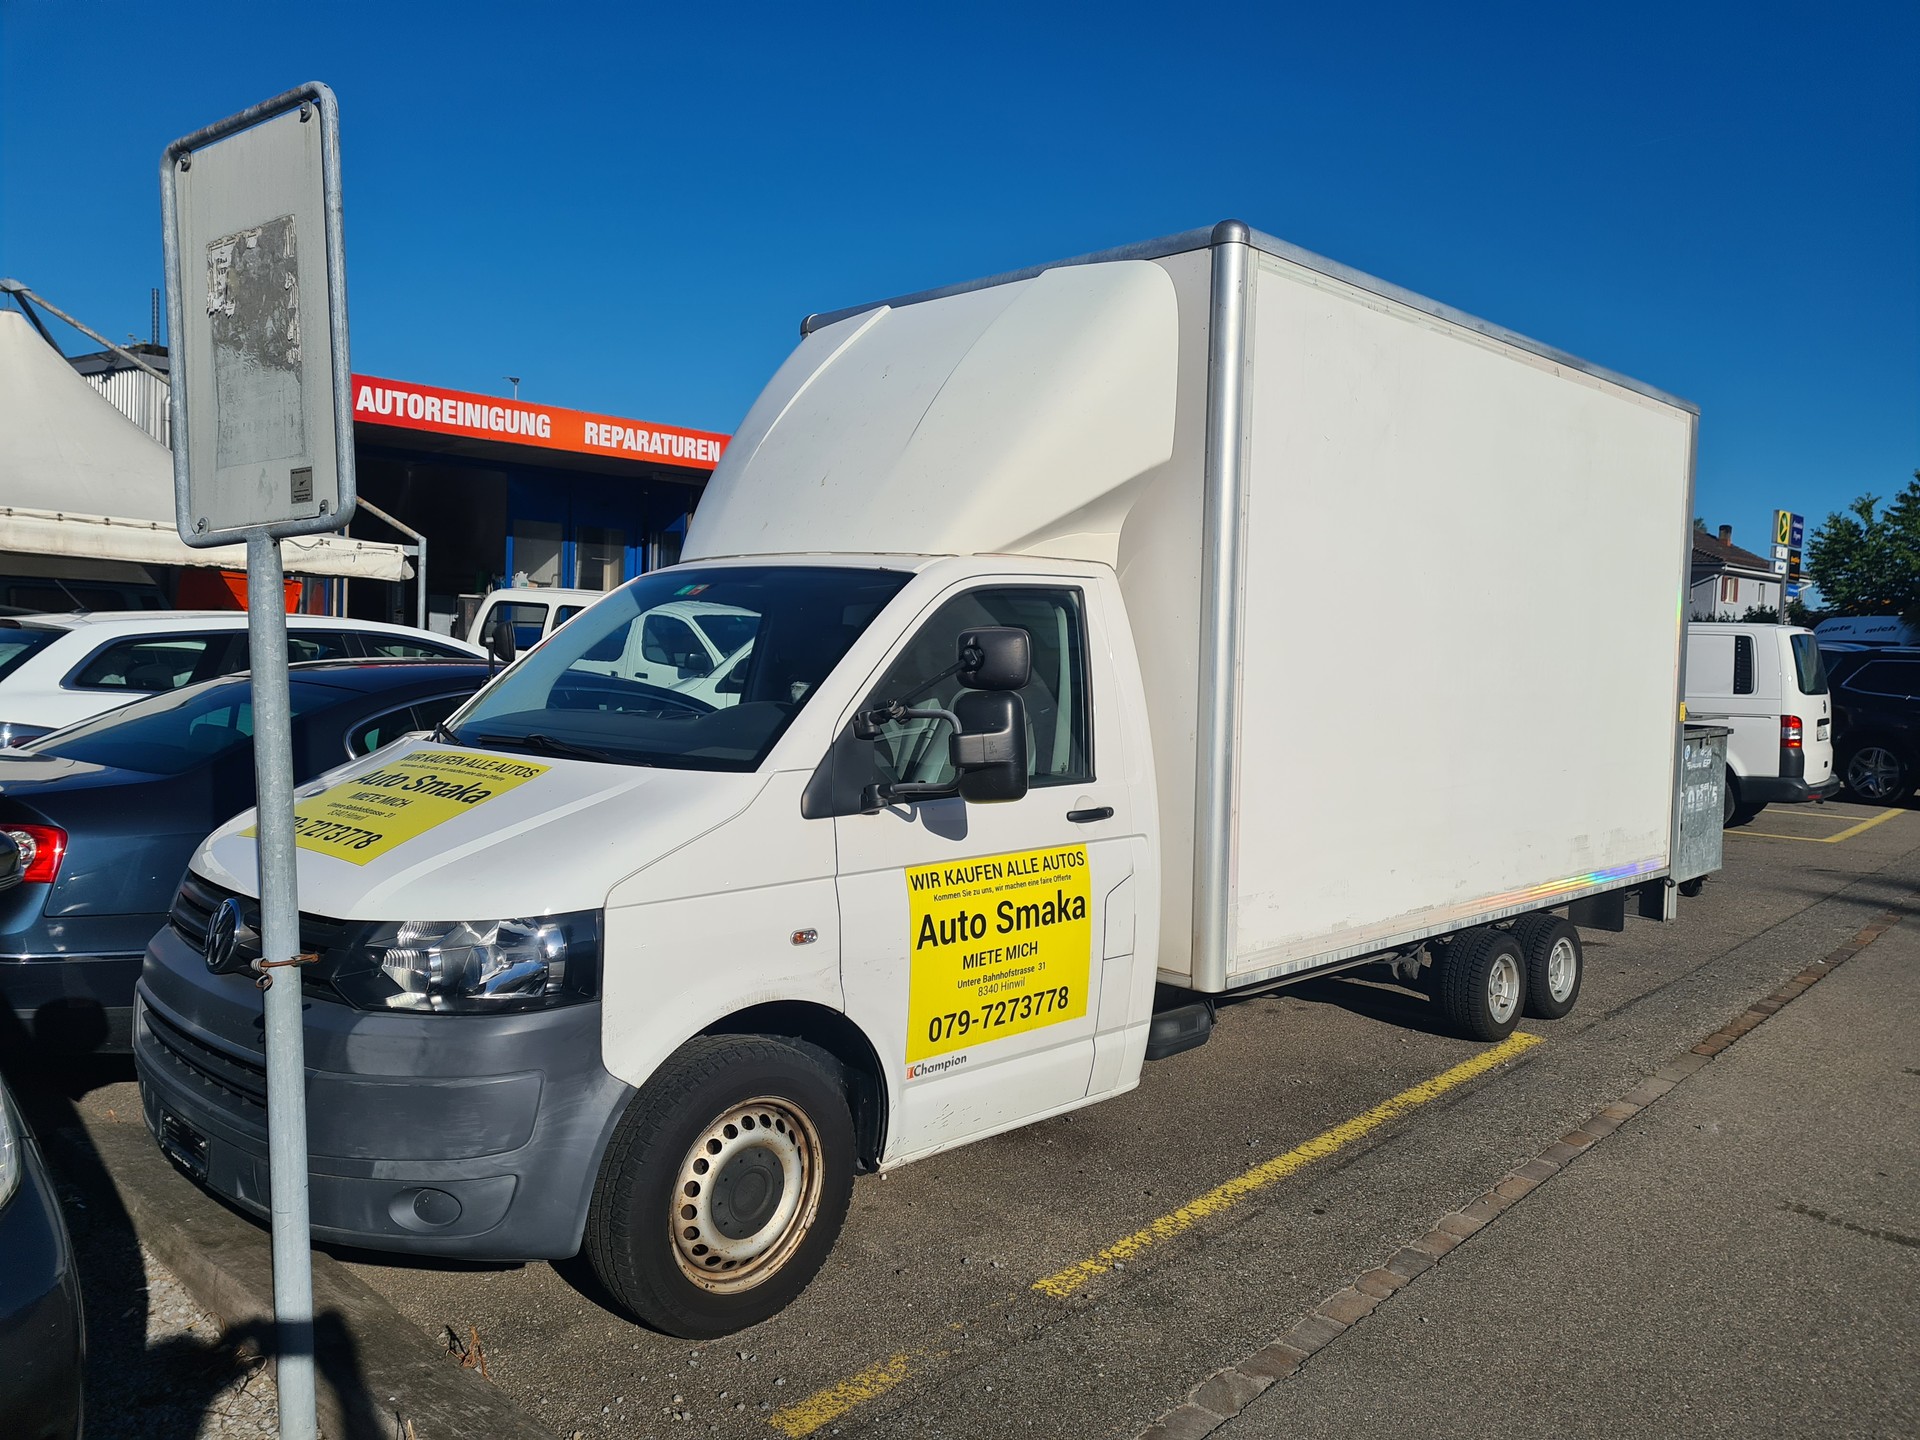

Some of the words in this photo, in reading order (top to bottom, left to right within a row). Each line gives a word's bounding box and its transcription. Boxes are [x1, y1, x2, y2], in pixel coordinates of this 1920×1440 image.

[355, 386, 551, 439] AUTOREINIGUNG
[584, 421, 721, 463] REPARATUREN
[1817, 624, 1852, 635] miete
[1865, 625, 1897, 634] mich
[425, 753, 467, 766] KAUFEN
[462, 757, 499, 770] ALLE
[493, 762, 540, 778] AUTOS
[348, 769, 410, 788] Auto
[401, 774, 492, 805] Smaka
[377, 795, 414, 809] MICH
[910, 872, 942, 891] WIR
[944, 862, 1003, 886] KAUFEN
[1007, 857, 1040, 878] ALLE
[1042, 850, 1085, 872] AUTOS
[933, 891, 961, 902] Kommen
[962, 888, 972, 898] Sie
[995, 884, 1004, 892] wir
[1005, 880, 1027, 890] machen
[1028, 879, 1040, 887] eine
[1040, 877, 1053, 885] faire
[1053, 874, 1072, 883] Offerte
[916, 910, 987, 950] Auto
[996, 889, 1087, 934] Smaka
[962, 948, 1003, 970] MIETE
[1005, 941, 1039, 961] MICH
[957, 977, 981, 989] Untere
[983, 965, 1035, 984] Bahnhofstrasse
[1038, 962, 1046, 971] 31
[977, 983, 999, 997] 8340
[1000, 975, 1026, 992] Hinwil
[928, 986, 1069, 1043] 079-7273778
[913, 1055, 967, 1077] Champion
